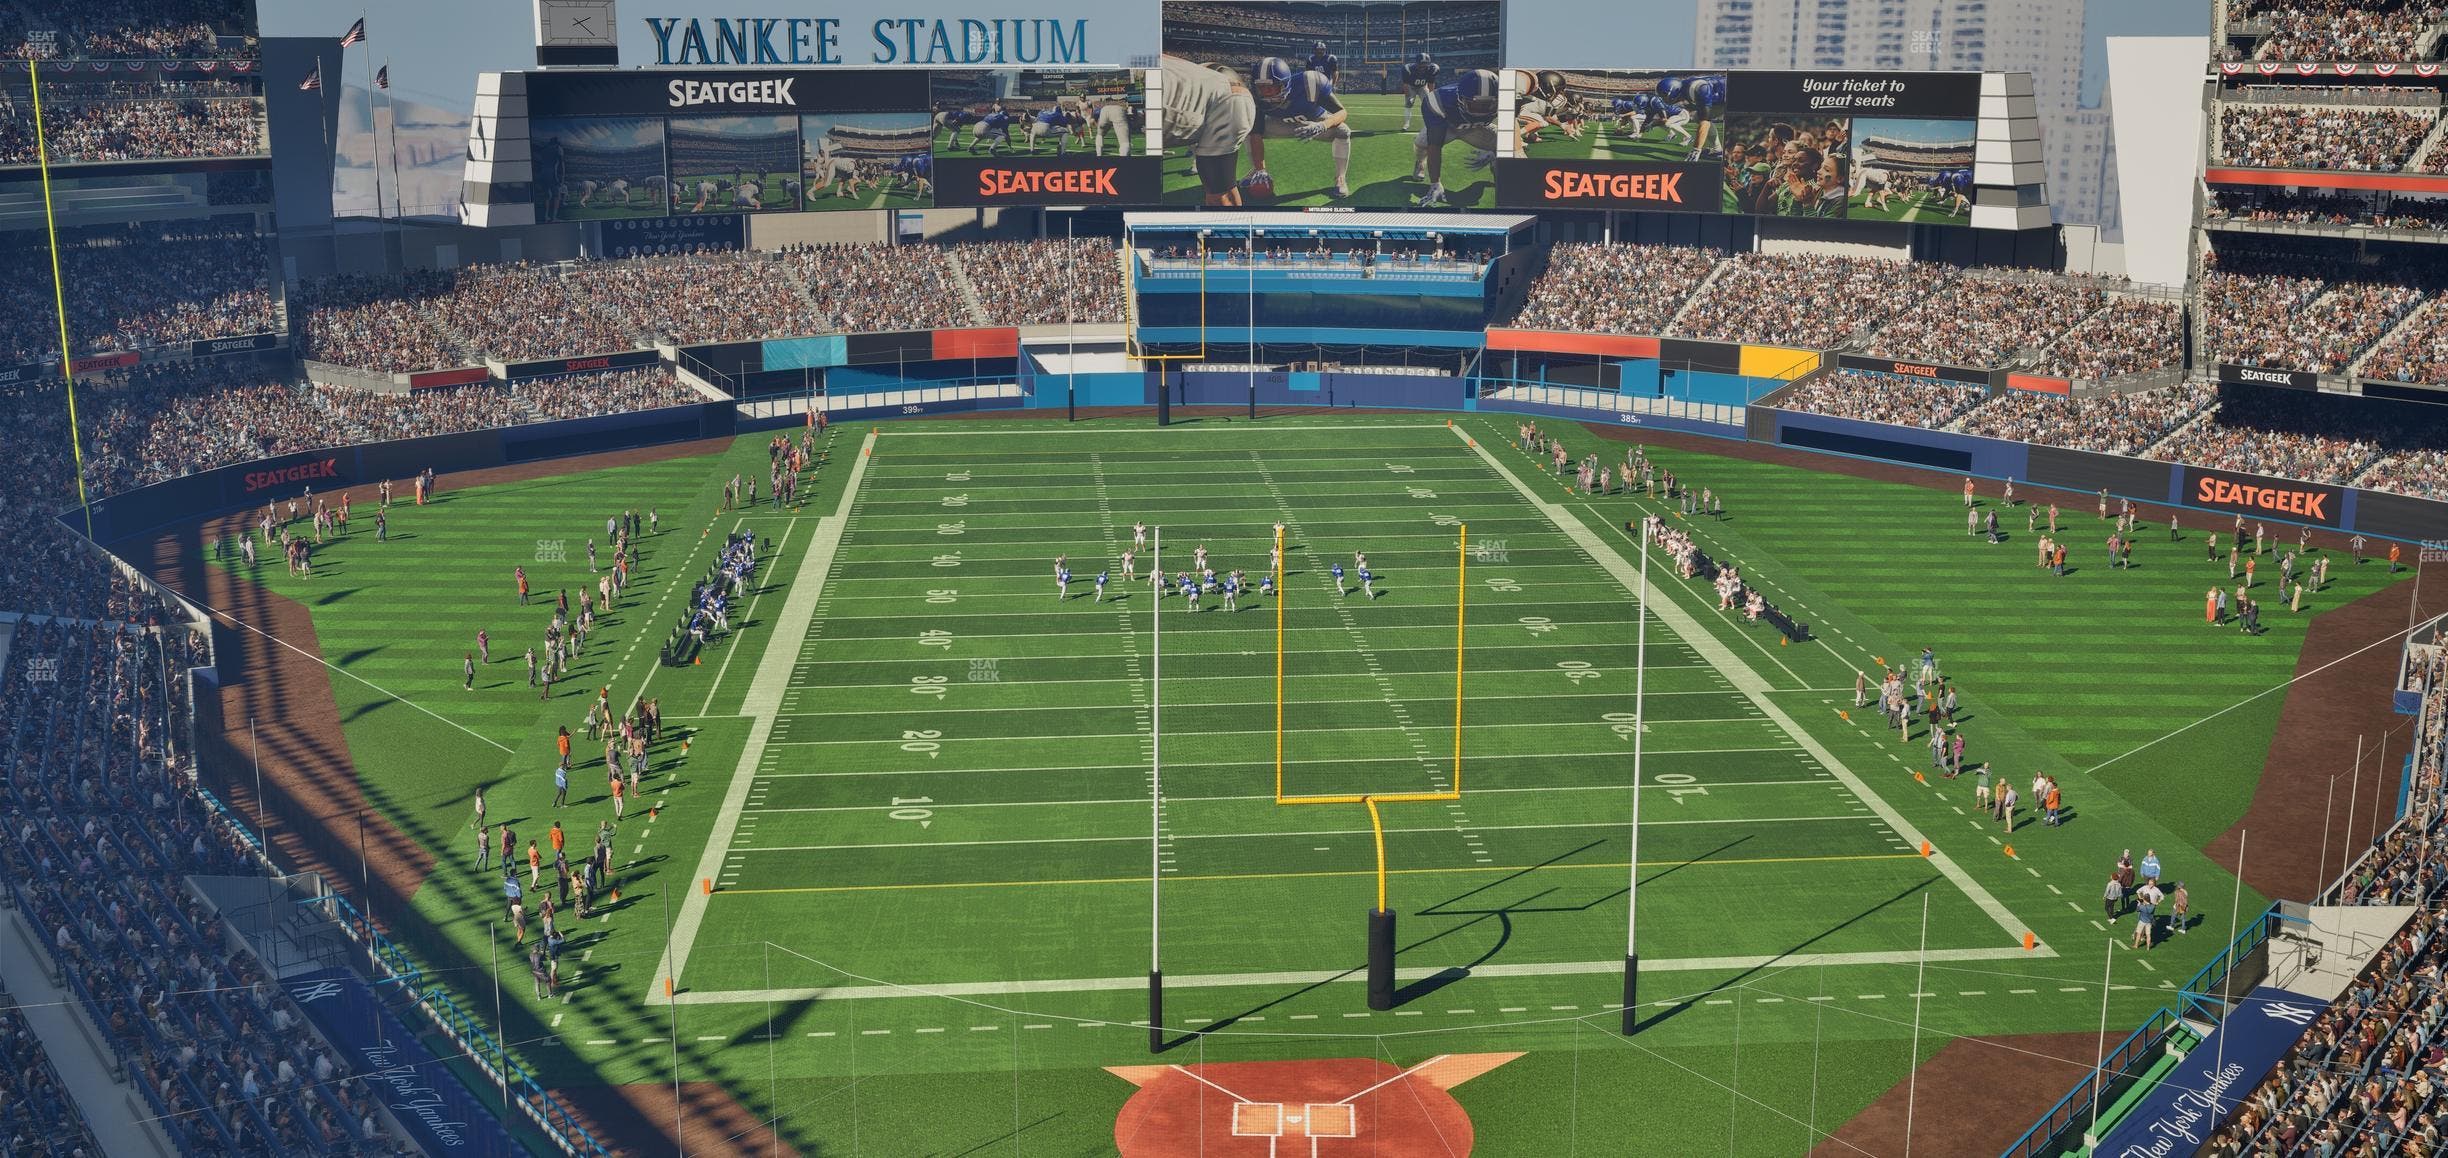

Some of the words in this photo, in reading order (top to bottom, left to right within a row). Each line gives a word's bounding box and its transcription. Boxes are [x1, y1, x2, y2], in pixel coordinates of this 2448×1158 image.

[644, 17, 842, 65] YANKEE
[871, 18, 1089, 64] STADIUM
[668, 77, 797, 107] SEATGEEK
[1802, 78, 1839, 93] Your
[1842, 79, 1887, 92] ticket
[1889, 79, 1905, 92] to
[1810, 94, 1853, 109] great
[1854, 94, 1896, 107] seats
[979, 167, 1119, 196] SEATGEEK
[1544, 169, 1684, 203] SEATGEEK
[211, 338, 255, 351] SEATGEEK
[78, 358, 120, 371] SEATGEEK
[566, 356, 610, 372] SEATGEEK
[1893, 362, 1938, 378] SEATGEEK
[2240, 368, 2292, 385] SEATGEEK
[244, 458, 337, 493] SEATGEEK
[2198, 476, 2328, 520] SEATGEEK
[918, 629, 953, 646] 40
[1556, 660, 1602, 679] 30
[910, 675, 948, 694] 30
[1601, 712, 1652, 734] 20
[900, 729, 942, 752] 20
[1654, 773, 1709, 796] 10
[889, 796, 933, 820] 10
[360, 1038, 398, 1068] New
[364, 1064, 435, 1096] York
[2149, 1103, 2203, 1145] York
[2178, 1062, 2245, 1115] Yankees
[390, 1093, 468, 1146] Yankees
